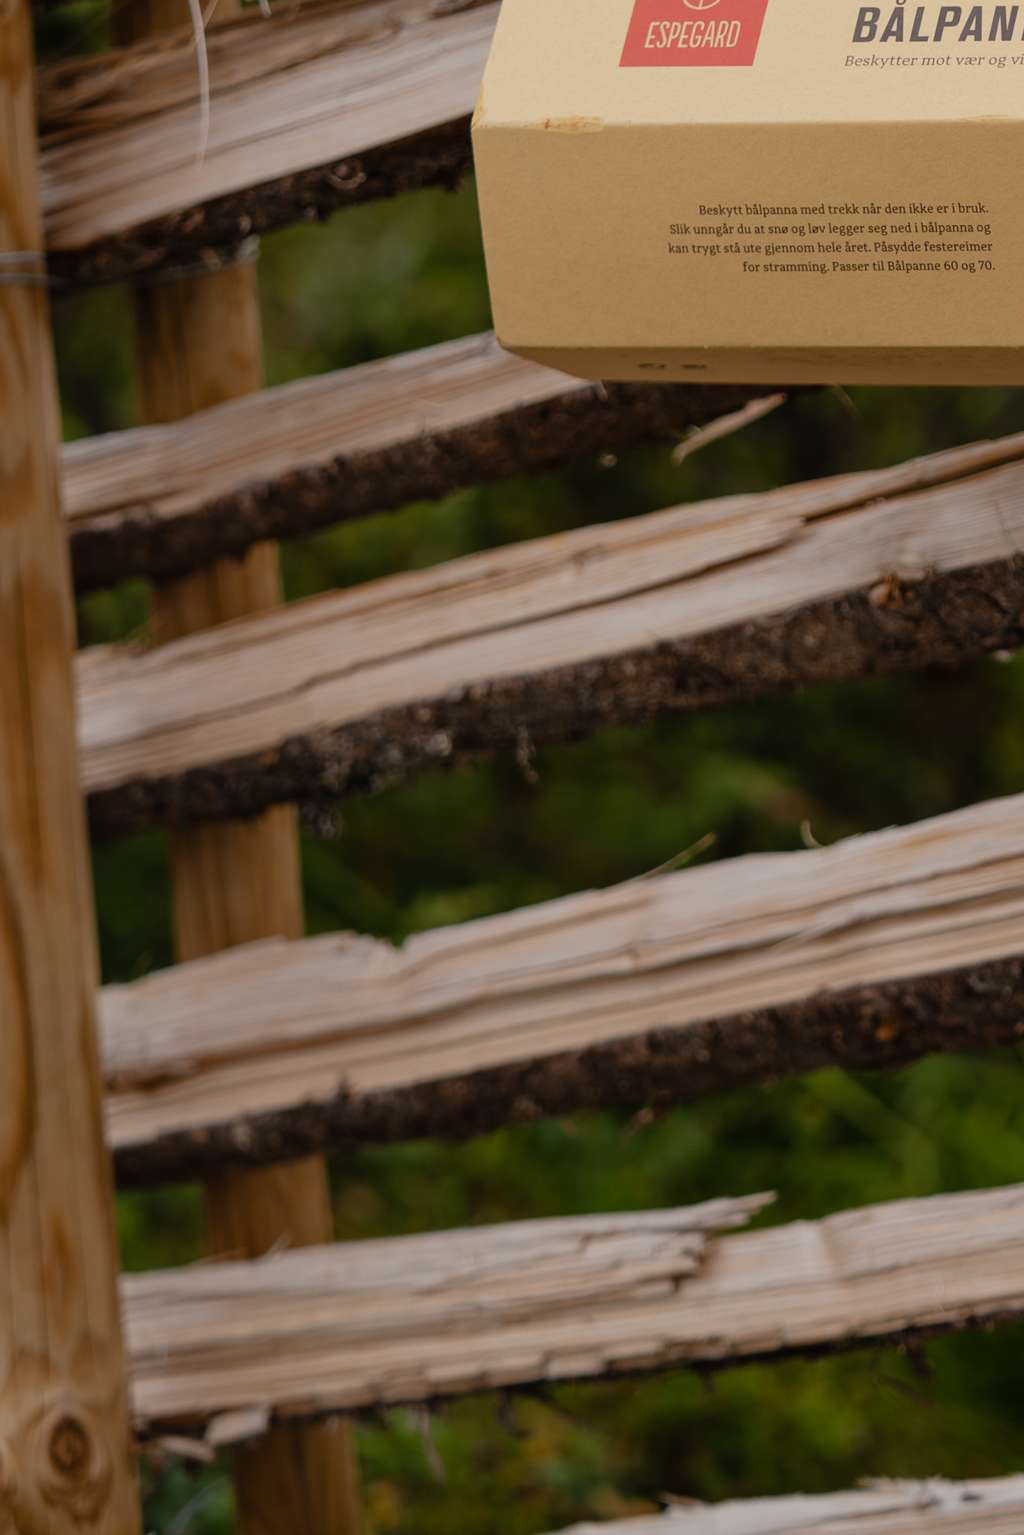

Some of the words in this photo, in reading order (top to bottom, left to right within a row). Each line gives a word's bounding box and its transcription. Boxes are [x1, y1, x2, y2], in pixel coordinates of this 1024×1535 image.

[643, 20, 741, 49] ESPEGARD
[844, 55, 917, 69] Beskytter
[921, 56, 951, 66] mot
[955, 58, 985, 66] vær
[988, 57, 1006, 69] og
[698, 204, 743, 218] Beskytt
[745, 203, 798, 218] bålpanna
[800, 203, 825, 215] med
[828, 203, 860, 215] trekk
[862, 203, 883, 215] når
[884, 203, 907, 214] den
[909, 202, 934, 214] ikke
[936, 204, 950, 214] er
[958, 202, 989, 214] bruk.
[669, 223, 691, 235] Slik
[692, 223, 735, 237] unngår
[737, 223, 752, 234] du
[754, 224, 766, 234] at
[768, 226, 789, 235] snø
[791, 225, 806, 237] og
[808, 222, 826, 234] løv
[828, 222, 865, 237] legger
[867, 225, 889, 237] seg
[890, 222, 912, 234] ned
[920, 221, 974, 237] bålpanna
[976, 224, 992, 236] og
[668, 243, 689, 254] kan
[691, 244, 722, 256] trygt
[723, 242, 741, 254] stå
[743, 244, 762, 254] ute
[764, 243, 815, 257] gjennom
[817, 241, 843, 253] hele
[845, 241, 872, 253] året.
[873, 241, 922, 256] Påsydde
[923, 241, 993, 253] festereimer
[742, 261, 761, 273] for
[763, 261, 830, 275] stramming.
[831, 261, 870, 273] Passer
[872, 260, 885, 272] til
[887, 260, 941, 275] Bålpanne
[943, 260, 959, 272] 60
[961, 262, 976, 274] og
[978, 260, 996, 272] 70.
